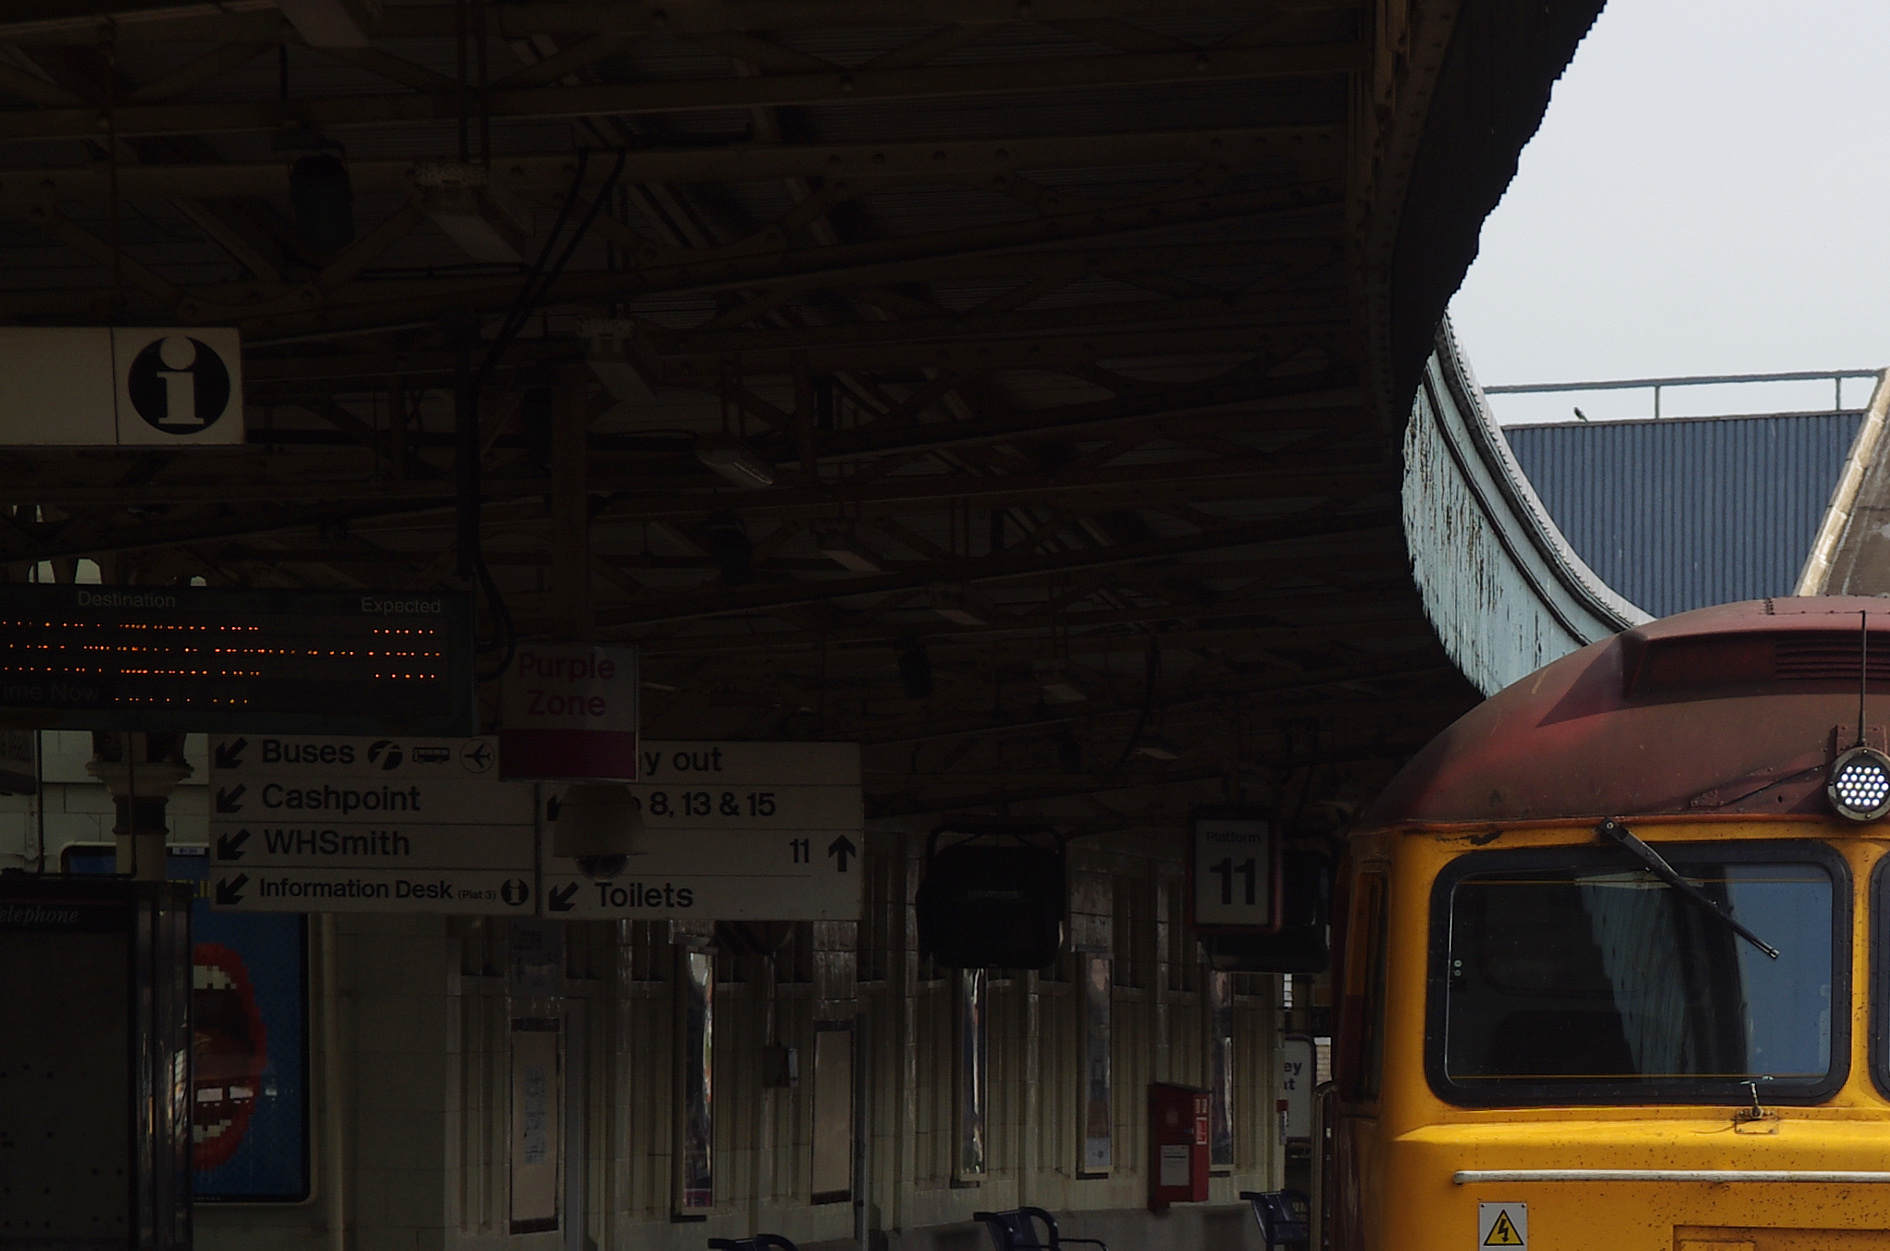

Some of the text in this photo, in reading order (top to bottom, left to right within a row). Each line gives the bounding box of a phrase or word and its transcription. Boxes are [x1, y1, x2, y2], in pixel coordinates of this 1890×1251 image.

[78, 590, 176, 608] Destination
[361, 596, 441, 616] Expected
[518, 653, 616, 683] Purple
[527, 689, 606, 717] Zone
[261, 739, 355, 764] Buses
[672, 747, 722, 772] out
[261, 783, 421, 815] Cashpoint
[649, 792, 674, 818] 8,
[681, 792, 712, 816] 13
[719, 792, 740, 817] &
[750, 792, 776, 817] 15
[263, 829, 410, 856] WHSmith
[1206, 830, 1261, 843] Platform
[789, 838, 810, 864] 11
[259, 877, 389, 898] Information
[395, 879, 453, 900] Desk
[1208, 857, 1256, 905] 11
[594, 882, 694, 908] Toilets
